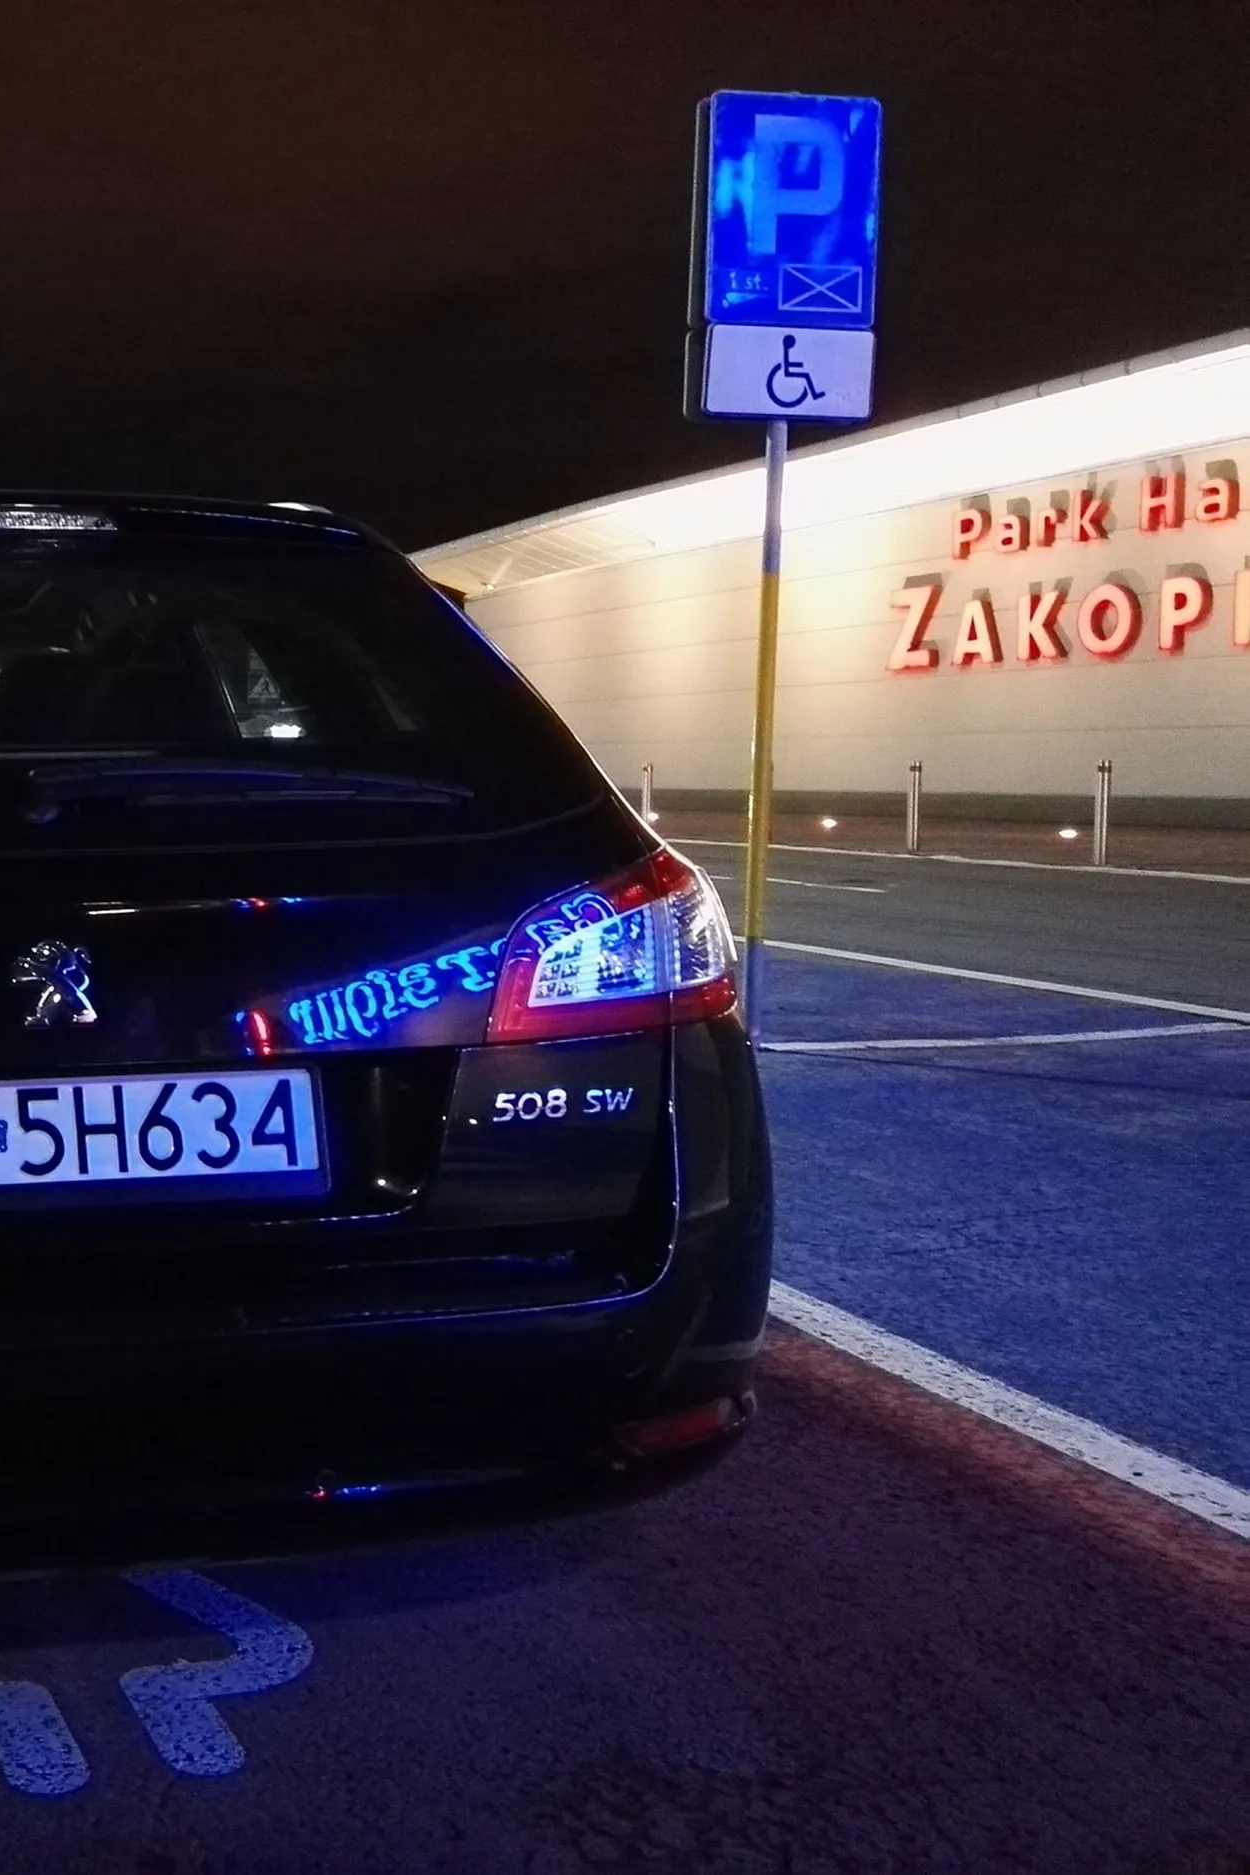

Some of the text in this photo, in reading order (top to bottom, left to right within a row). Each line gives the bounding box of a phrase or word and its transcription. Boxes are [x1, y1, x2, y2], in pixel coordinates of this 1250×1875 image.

[749, 114, 844, 254] P
[952, 489, 1109, 560] Park
[15, 1078, 299, 1177] 5H634
[492, 1087, 634, 1122] 508 SW
